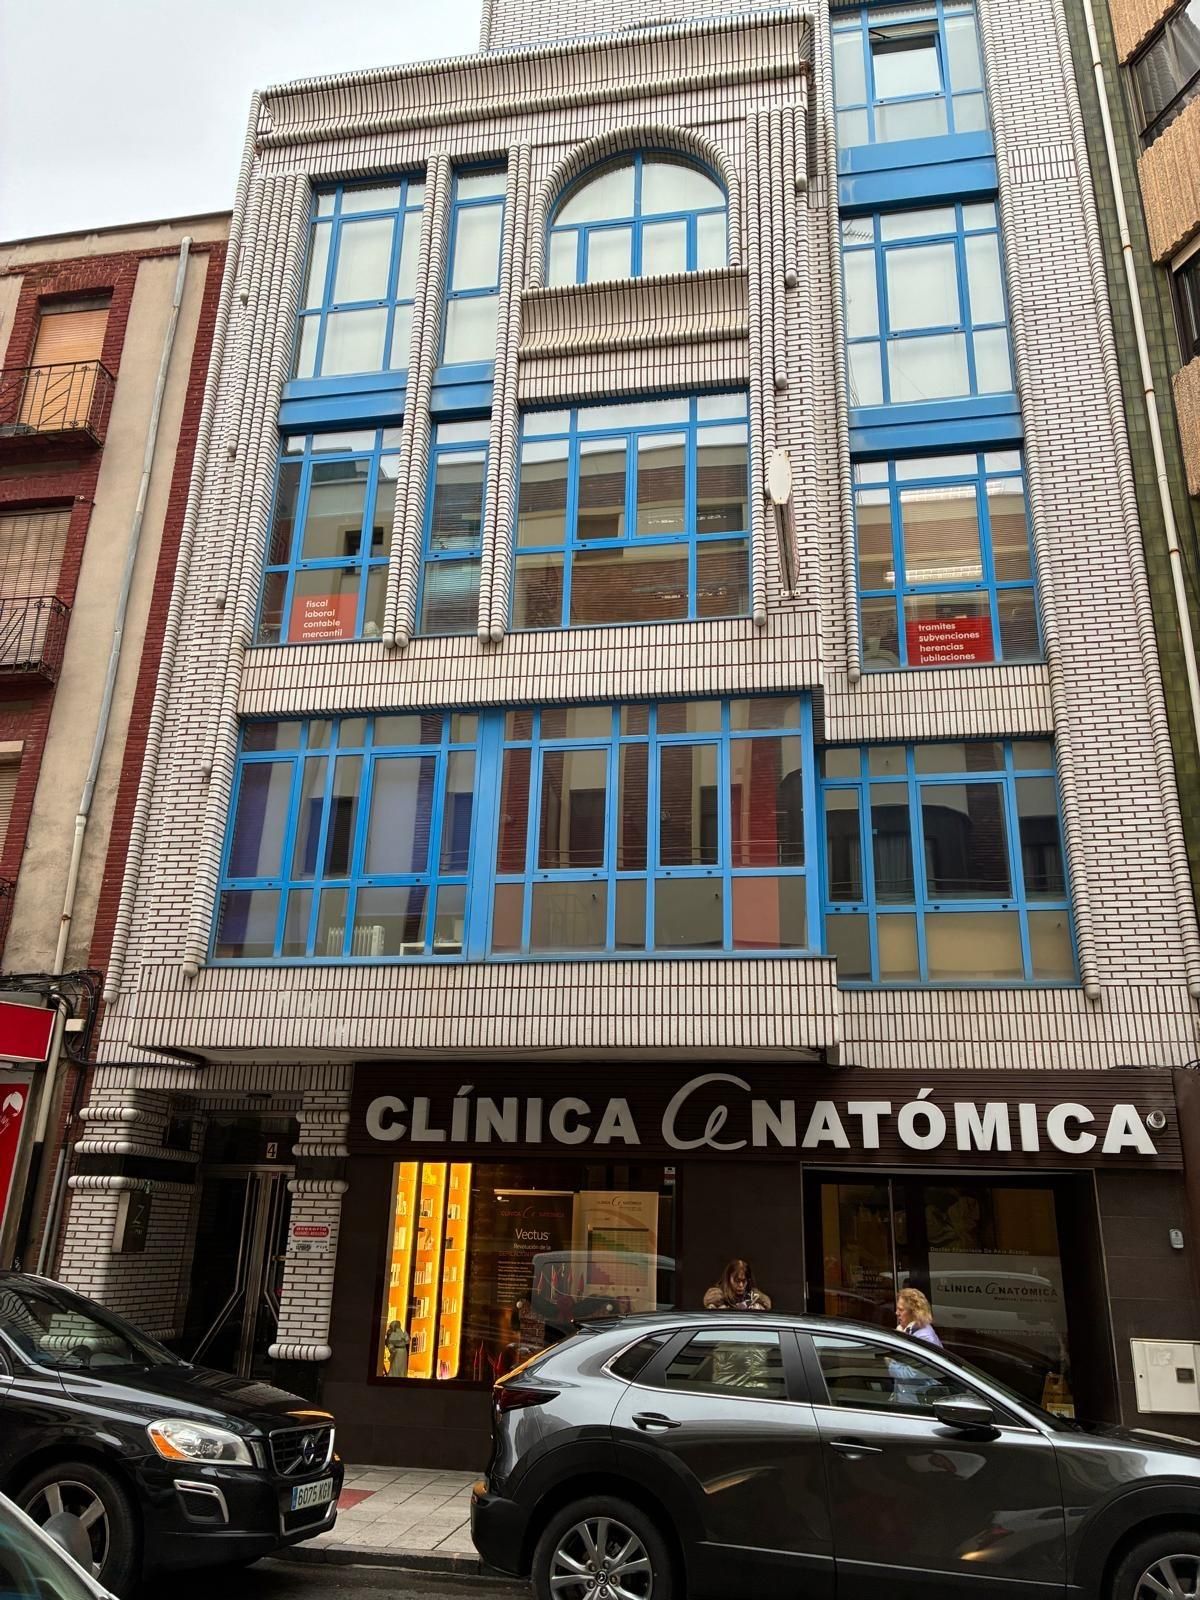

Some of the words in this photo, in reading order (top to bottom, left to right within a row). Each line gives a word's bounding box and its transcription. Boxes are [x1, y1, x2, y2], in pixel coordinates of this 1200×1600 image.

[306, 600, 328, 608] fiscal
[304, 609, 336, 618] laboral
[304, 620, 340, 628] contable
[918, 623, 956, 632] tramites
[302, 629, 343, 638] mercantil
[919, 632, 980, 642] subvenciones
[920, 643, 964, 652] herencias
[920, 654, 976, 664] jubilaciones
[366, 1085, 641, 1144] CLÍNICA
[267, 1143, 276, 1157] 4
[515, 1228, 549, 1241] Vectus
[937, 1283, 982, 1294] CLÍNICA
[298, 1486, 318, 1506] 6075
